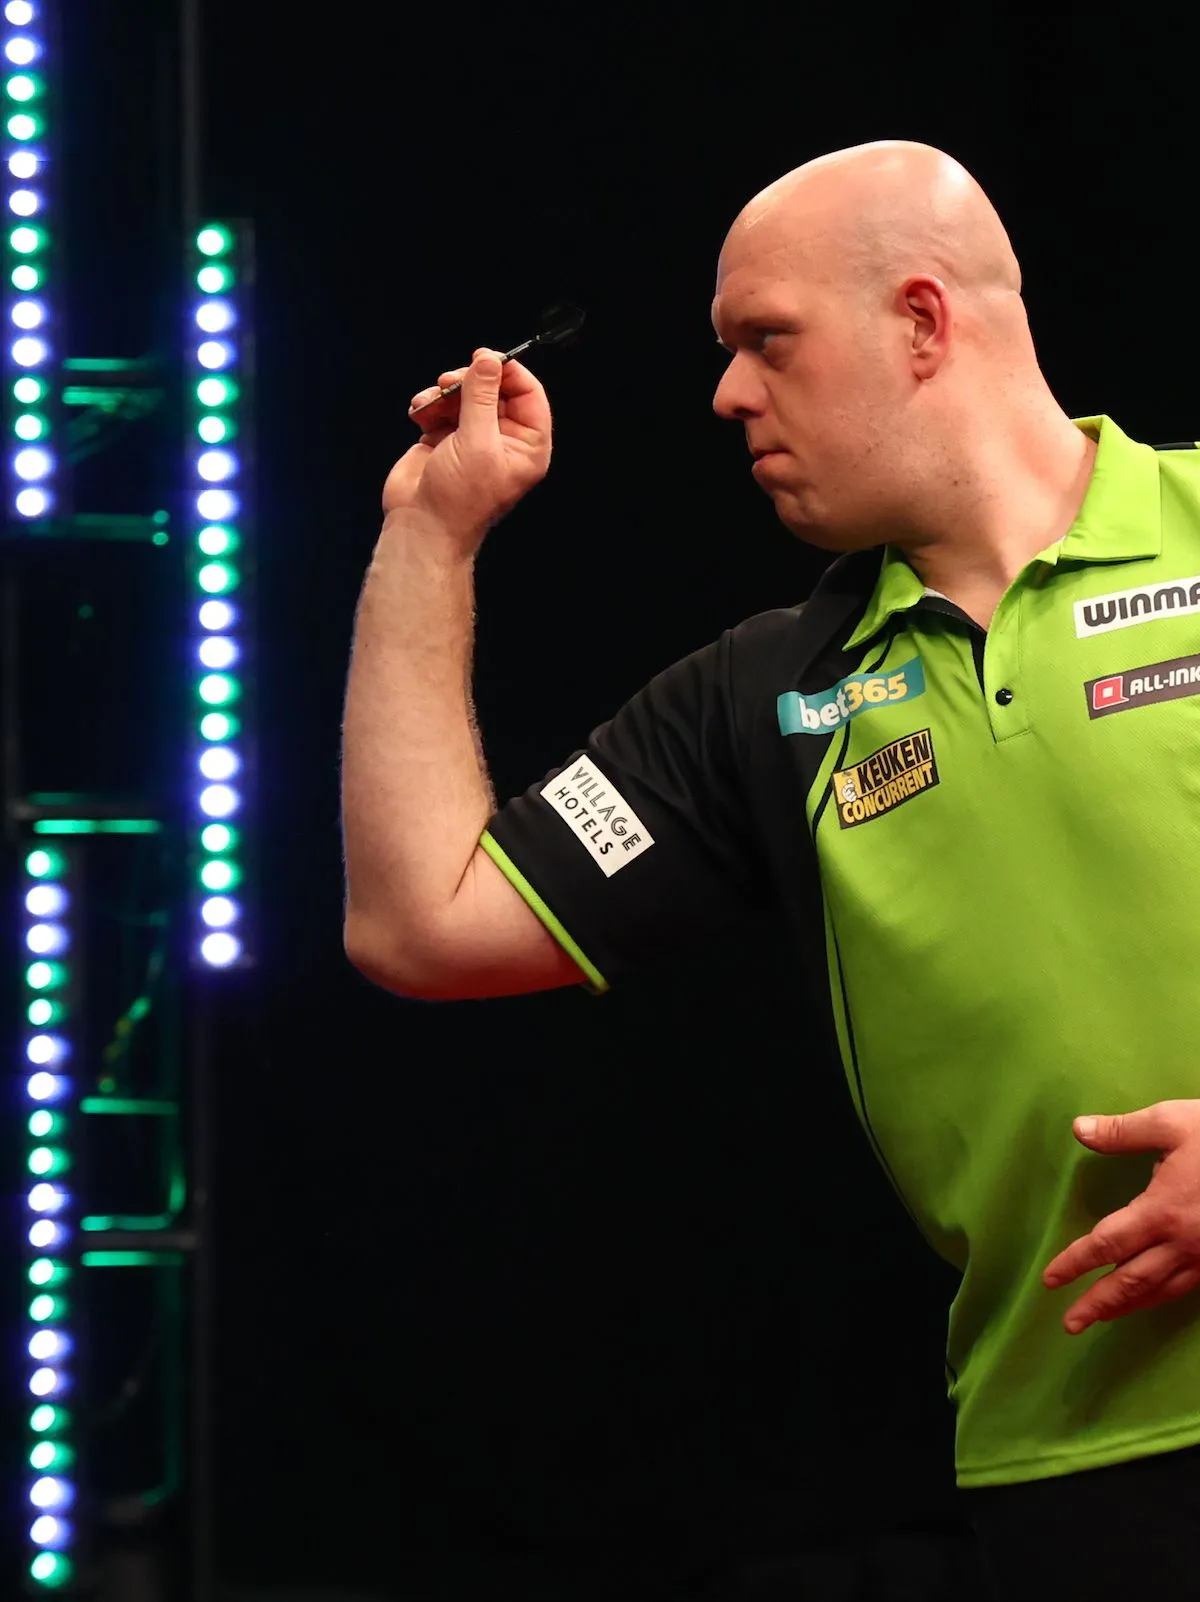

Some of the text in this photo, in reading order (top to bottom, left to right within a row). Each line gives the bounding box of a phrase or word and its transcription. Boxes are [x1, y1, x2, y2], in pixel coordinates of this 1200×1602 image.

[798, 672, 908, 730] bet365
[842, 763, 935, 824] CONCURRENT
[856, 733, 931, 794] KEUKEN
[554, 786, 613, 855] HOTELS
[570, 766, 642, 852] VILLAGE
